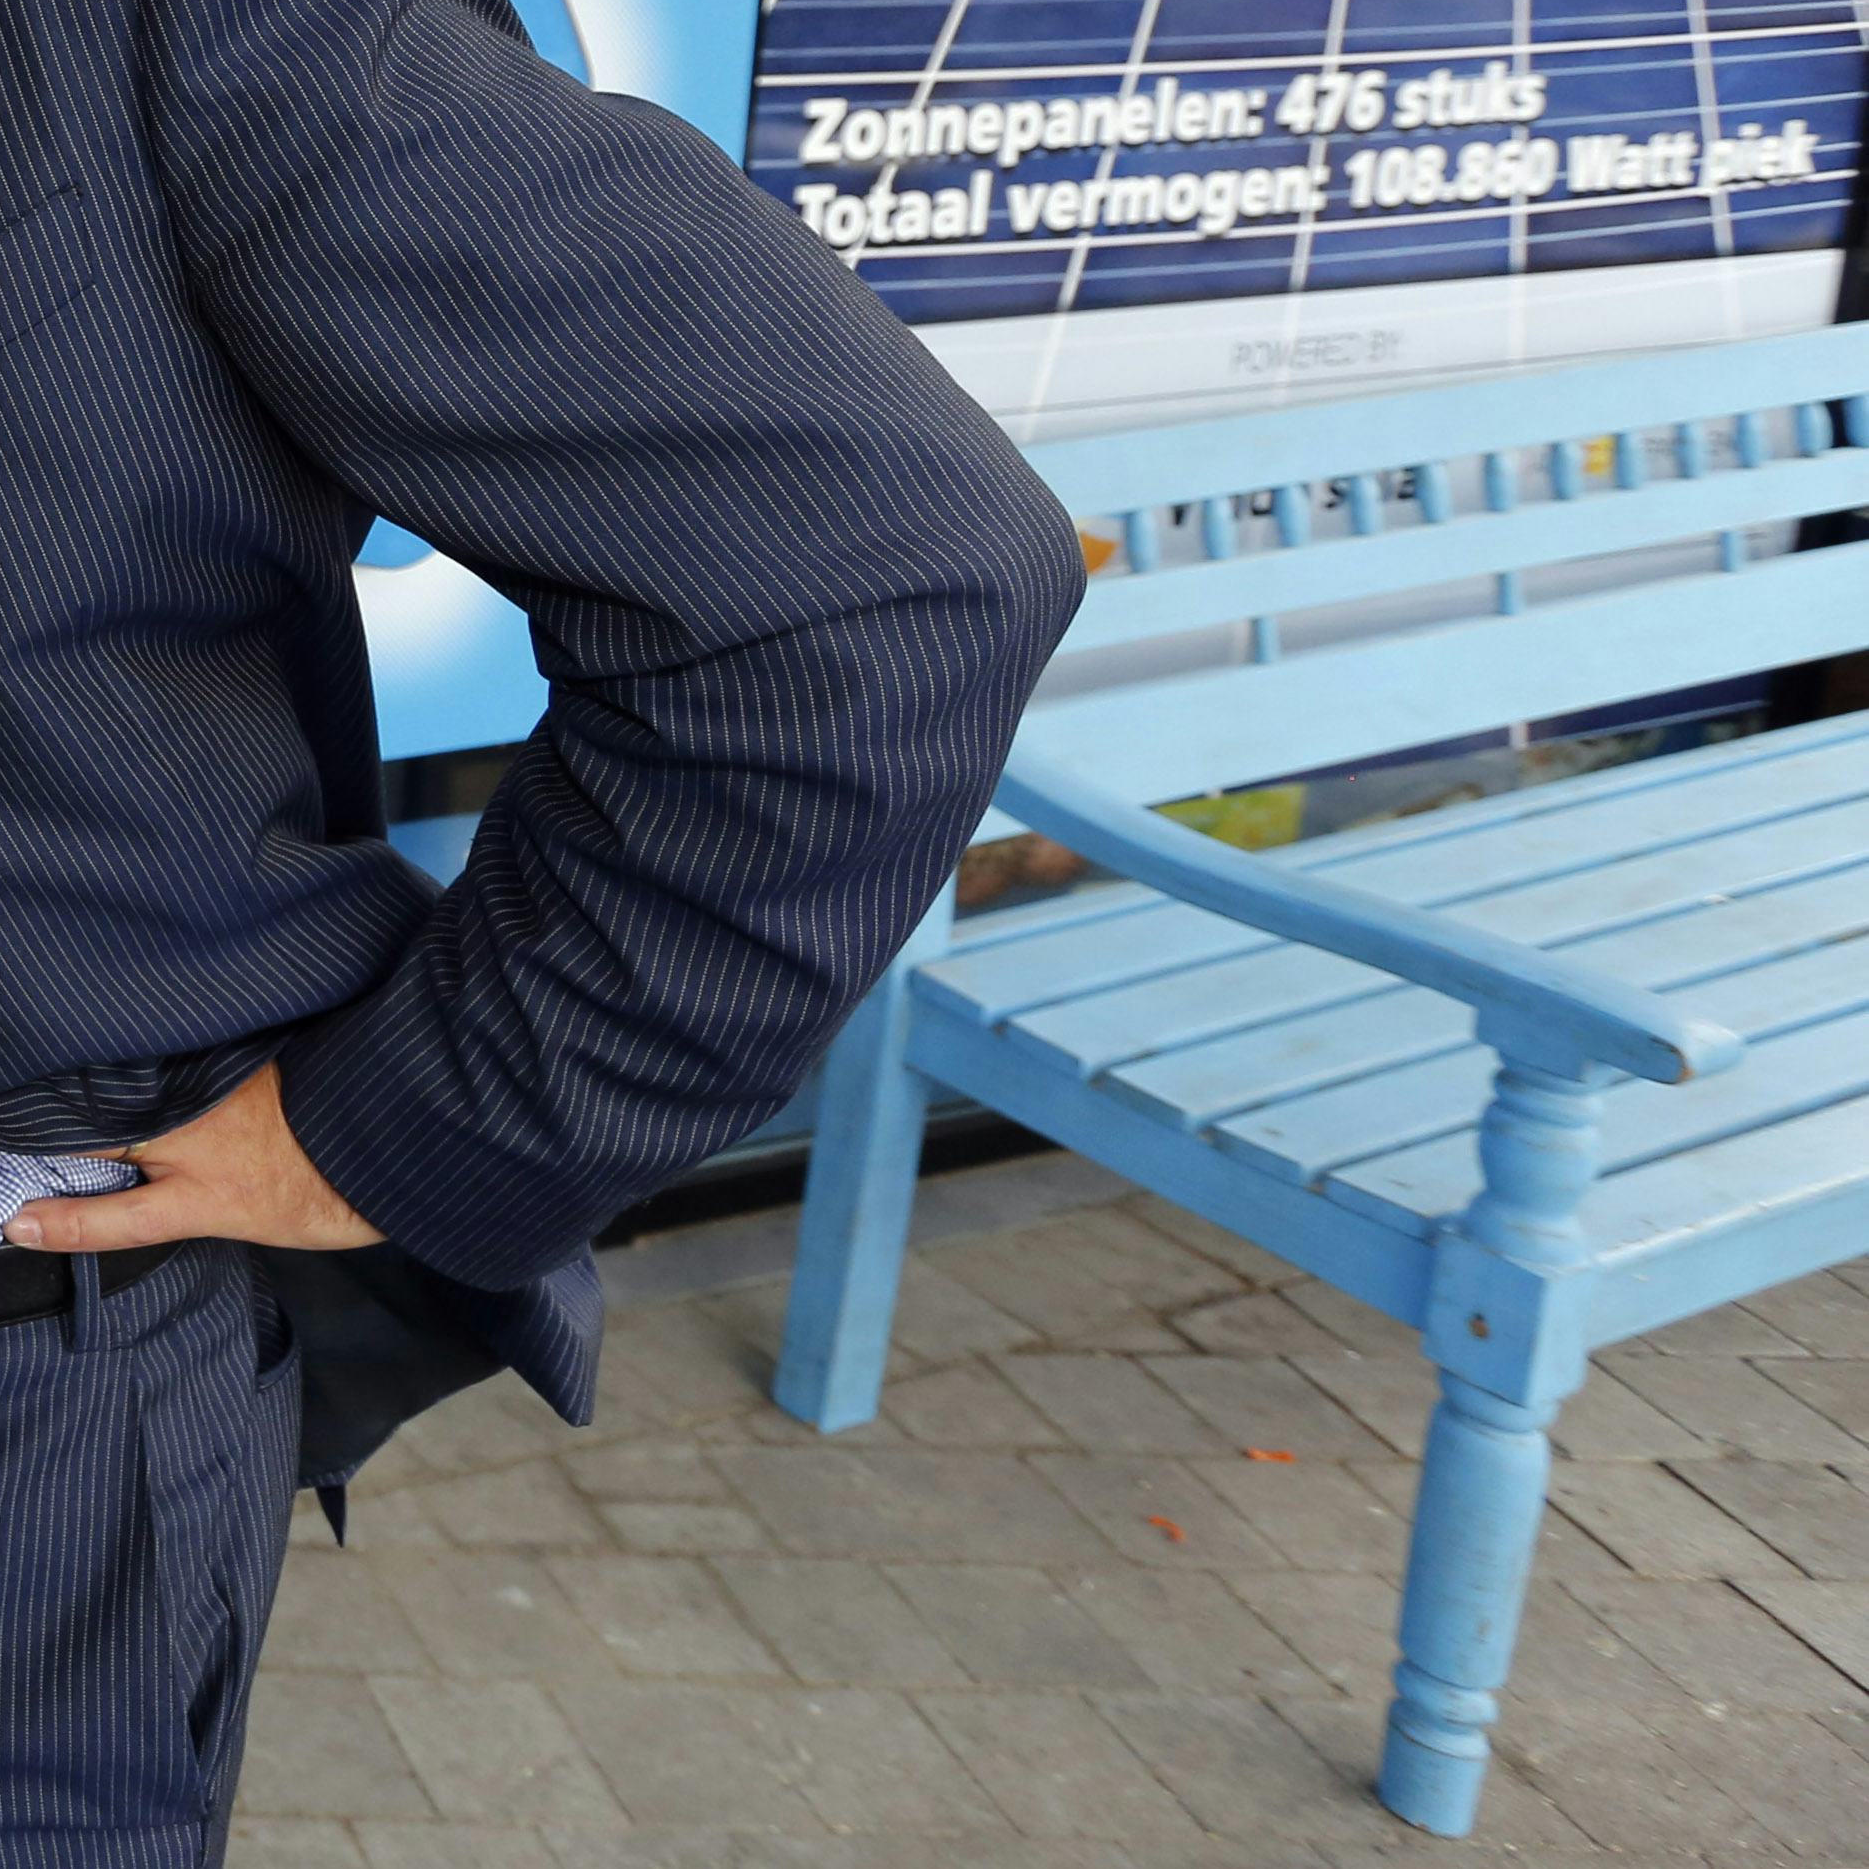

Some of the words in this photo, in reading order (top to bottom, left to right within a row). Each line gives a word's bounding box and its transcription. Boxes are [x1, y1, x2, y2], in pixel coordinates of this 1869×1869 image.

[799, 76, 1266, 169] Zonnepanelen:
[1275, 69, 1387, 135] 476
[1392, 60, 1546, 133] stuks
[794, 164, 989, 249] Totaal
[1007, 153, 1330, 237] vermogen:
[1567, 128, 1696, 195] Watt
[1702, 121, 1817, 191] piek
